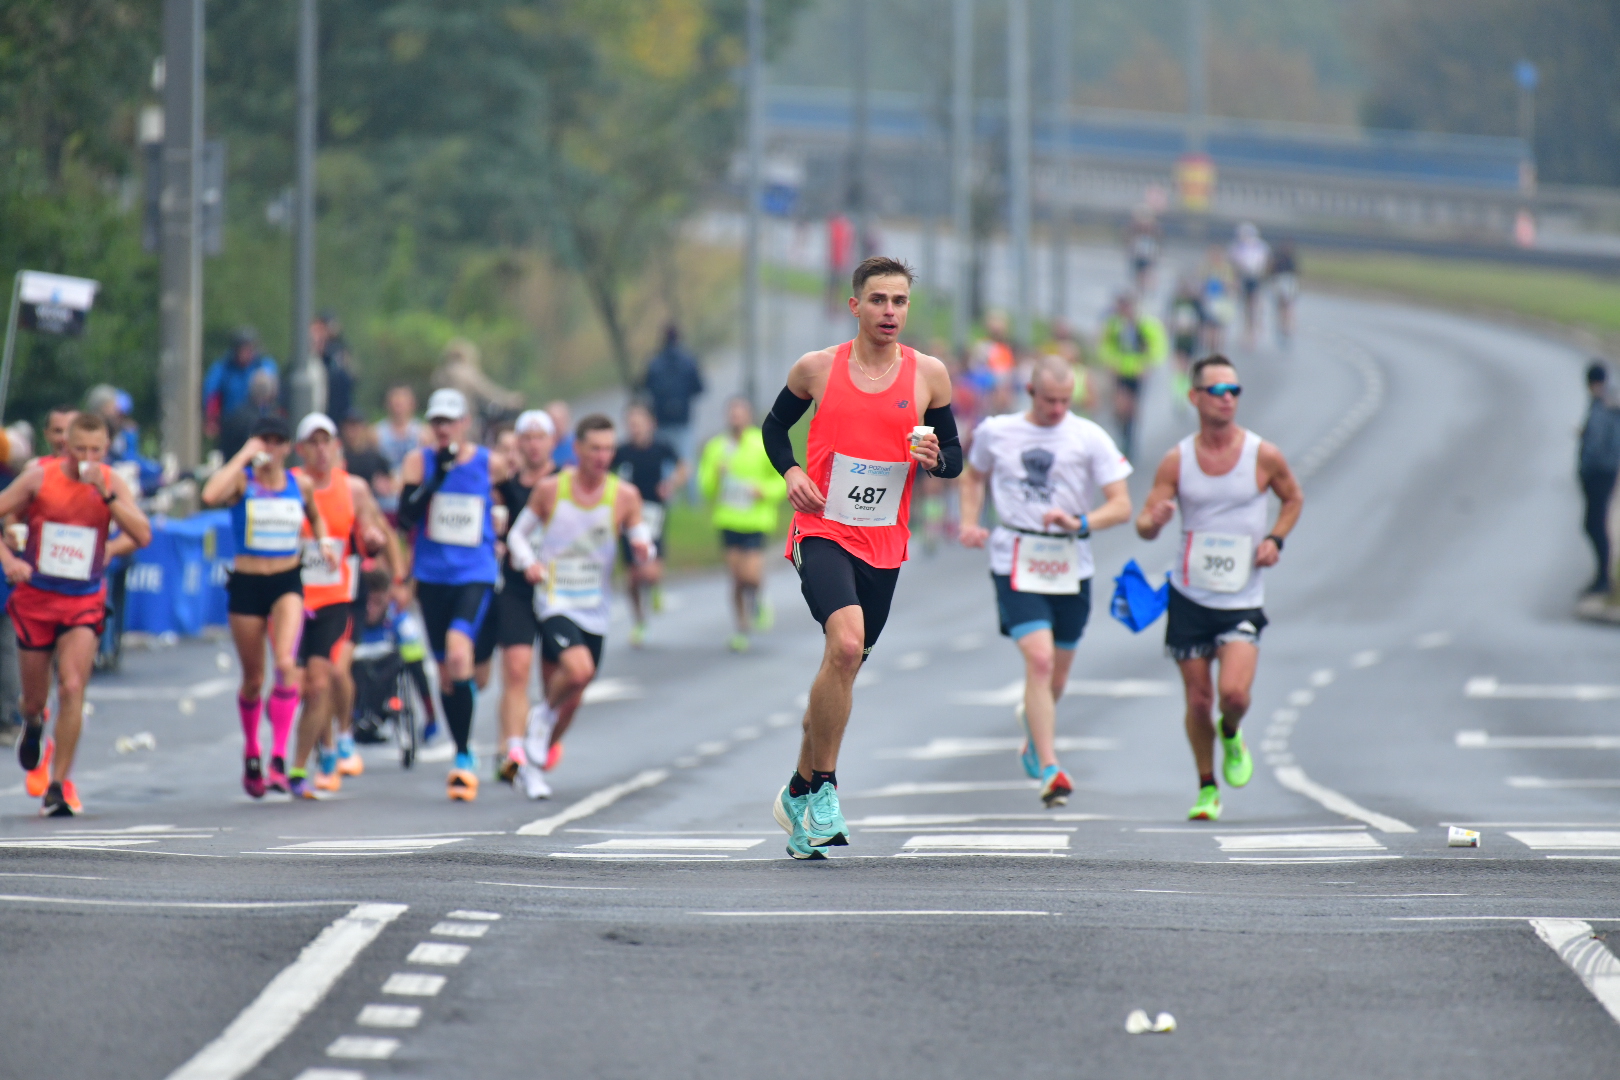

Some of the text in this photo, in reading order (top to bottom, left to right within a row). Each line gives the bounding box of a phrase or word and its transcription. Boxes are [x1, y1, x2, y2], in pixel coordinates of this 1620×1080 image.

[850, 462, 867, 475] 22
[847, 485, 887, 505] 487
[854, 503, 876, 511] Cezary
[1203, 554, 1236, 573] 390
